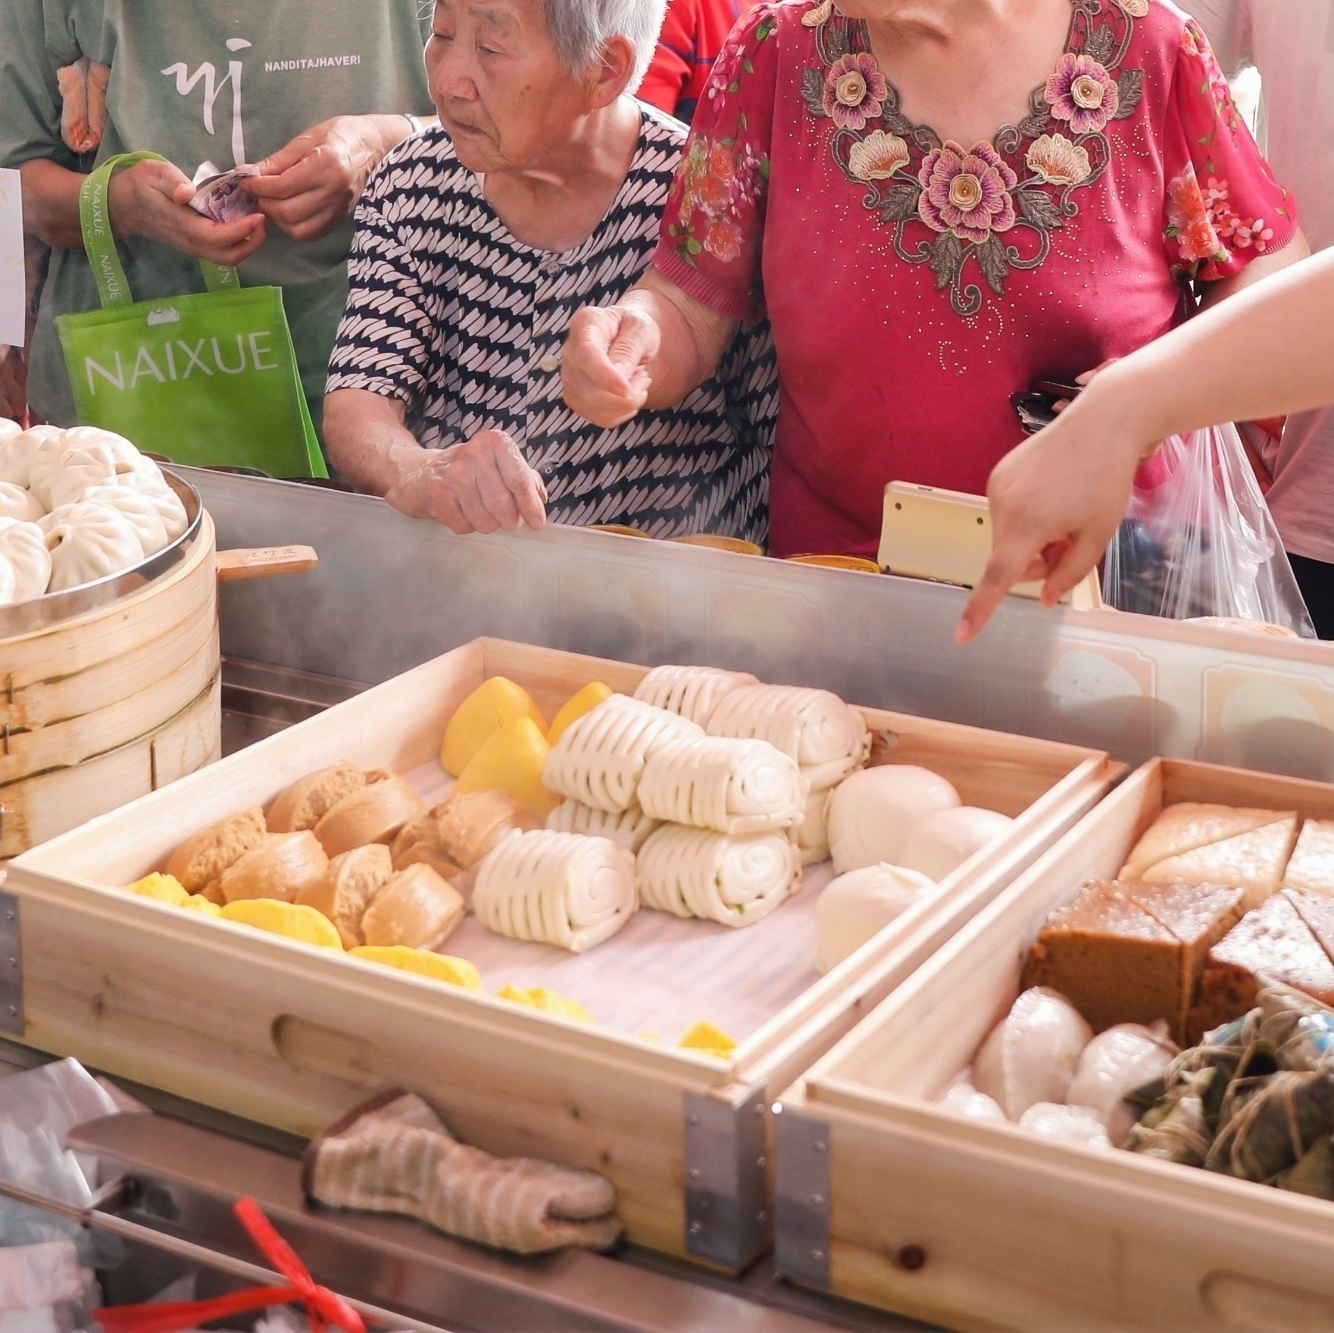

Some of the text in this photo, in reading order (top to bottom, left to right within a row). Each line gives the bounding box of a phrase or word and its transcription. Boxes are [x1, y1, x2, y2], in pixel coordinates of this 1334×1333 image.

[264, 54, 361, 72] NANDITAJHAVERI
[91, 183, 105, 237] NAIXUE
[99, 254, 122, 300] NAIXUE
[84, 330, 279, 396] NAIXUE
